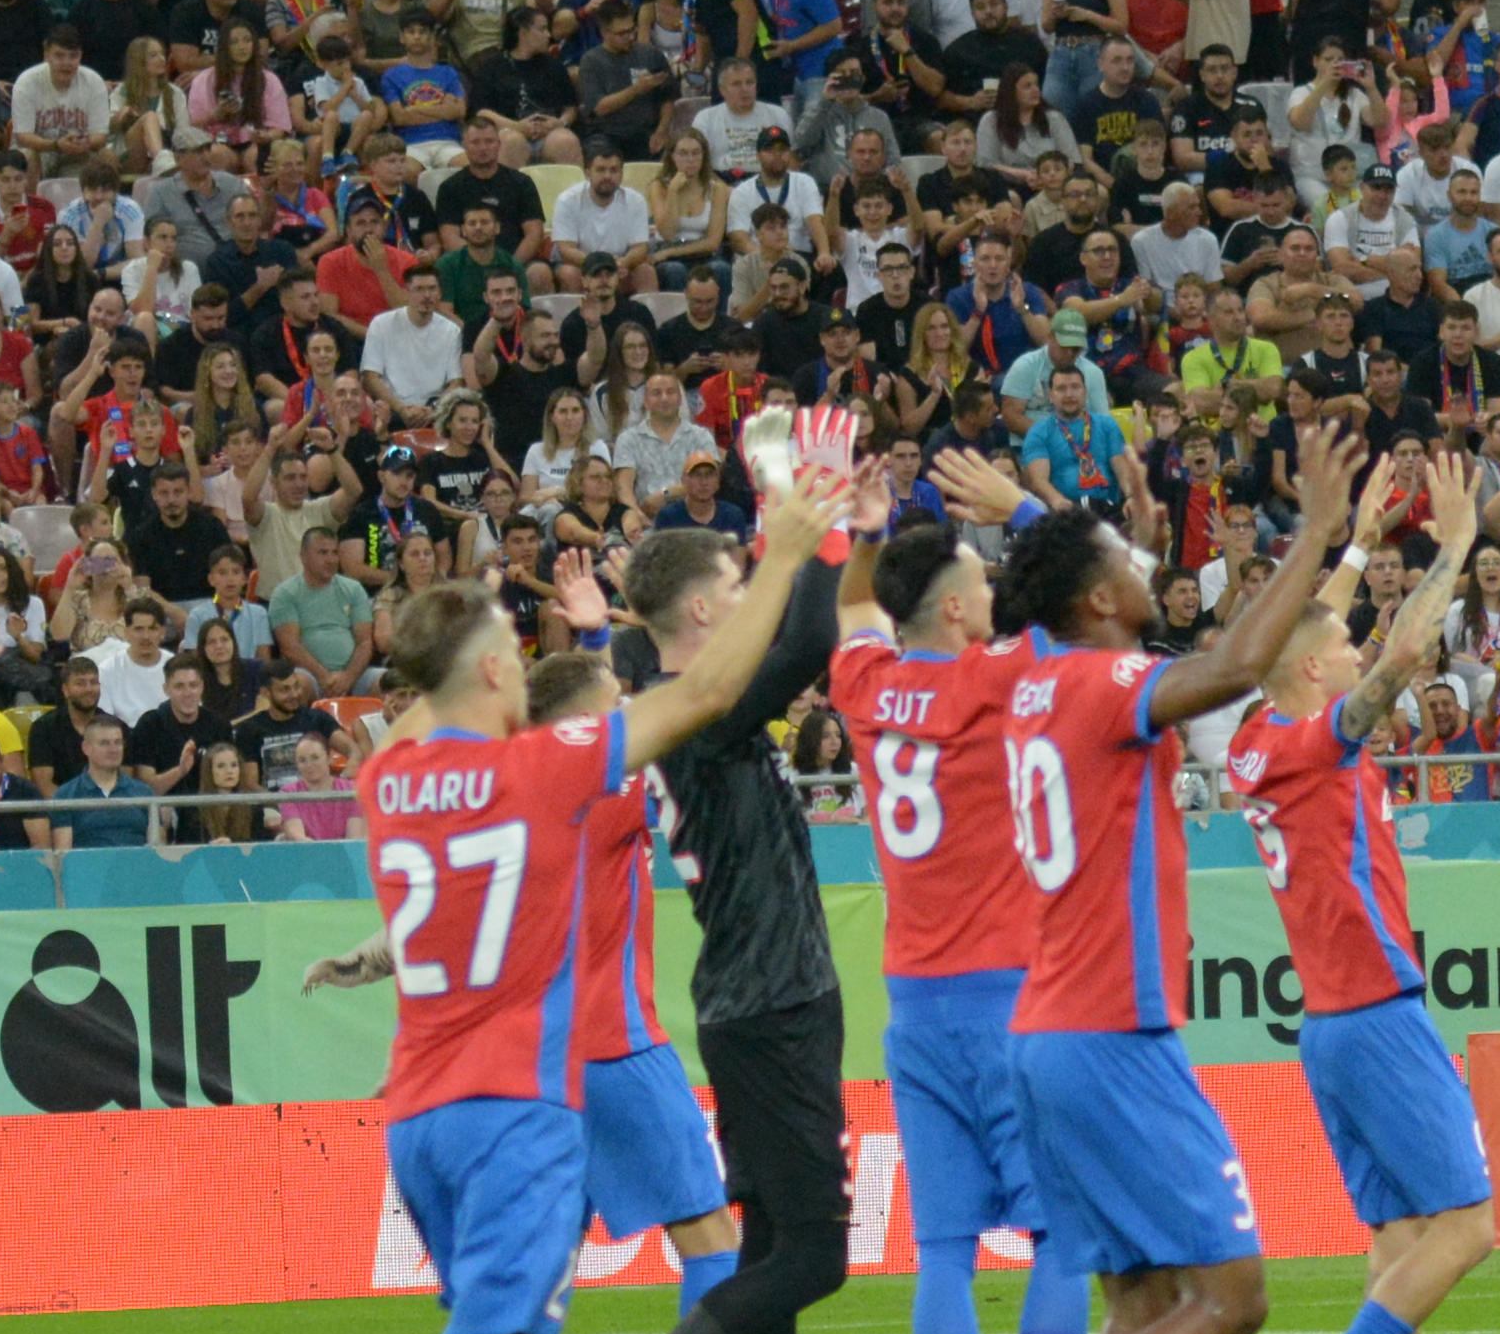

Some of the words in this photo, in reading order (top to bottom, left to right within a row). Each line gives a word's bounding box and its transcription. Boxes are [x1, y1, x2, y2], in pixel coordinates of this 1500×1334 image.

[873, 688, 938, 727] SUT
[377, 767, 495, 815] OLARU
[874, 731, 945, 861] 8
[378, 819, 527, 999] 27
